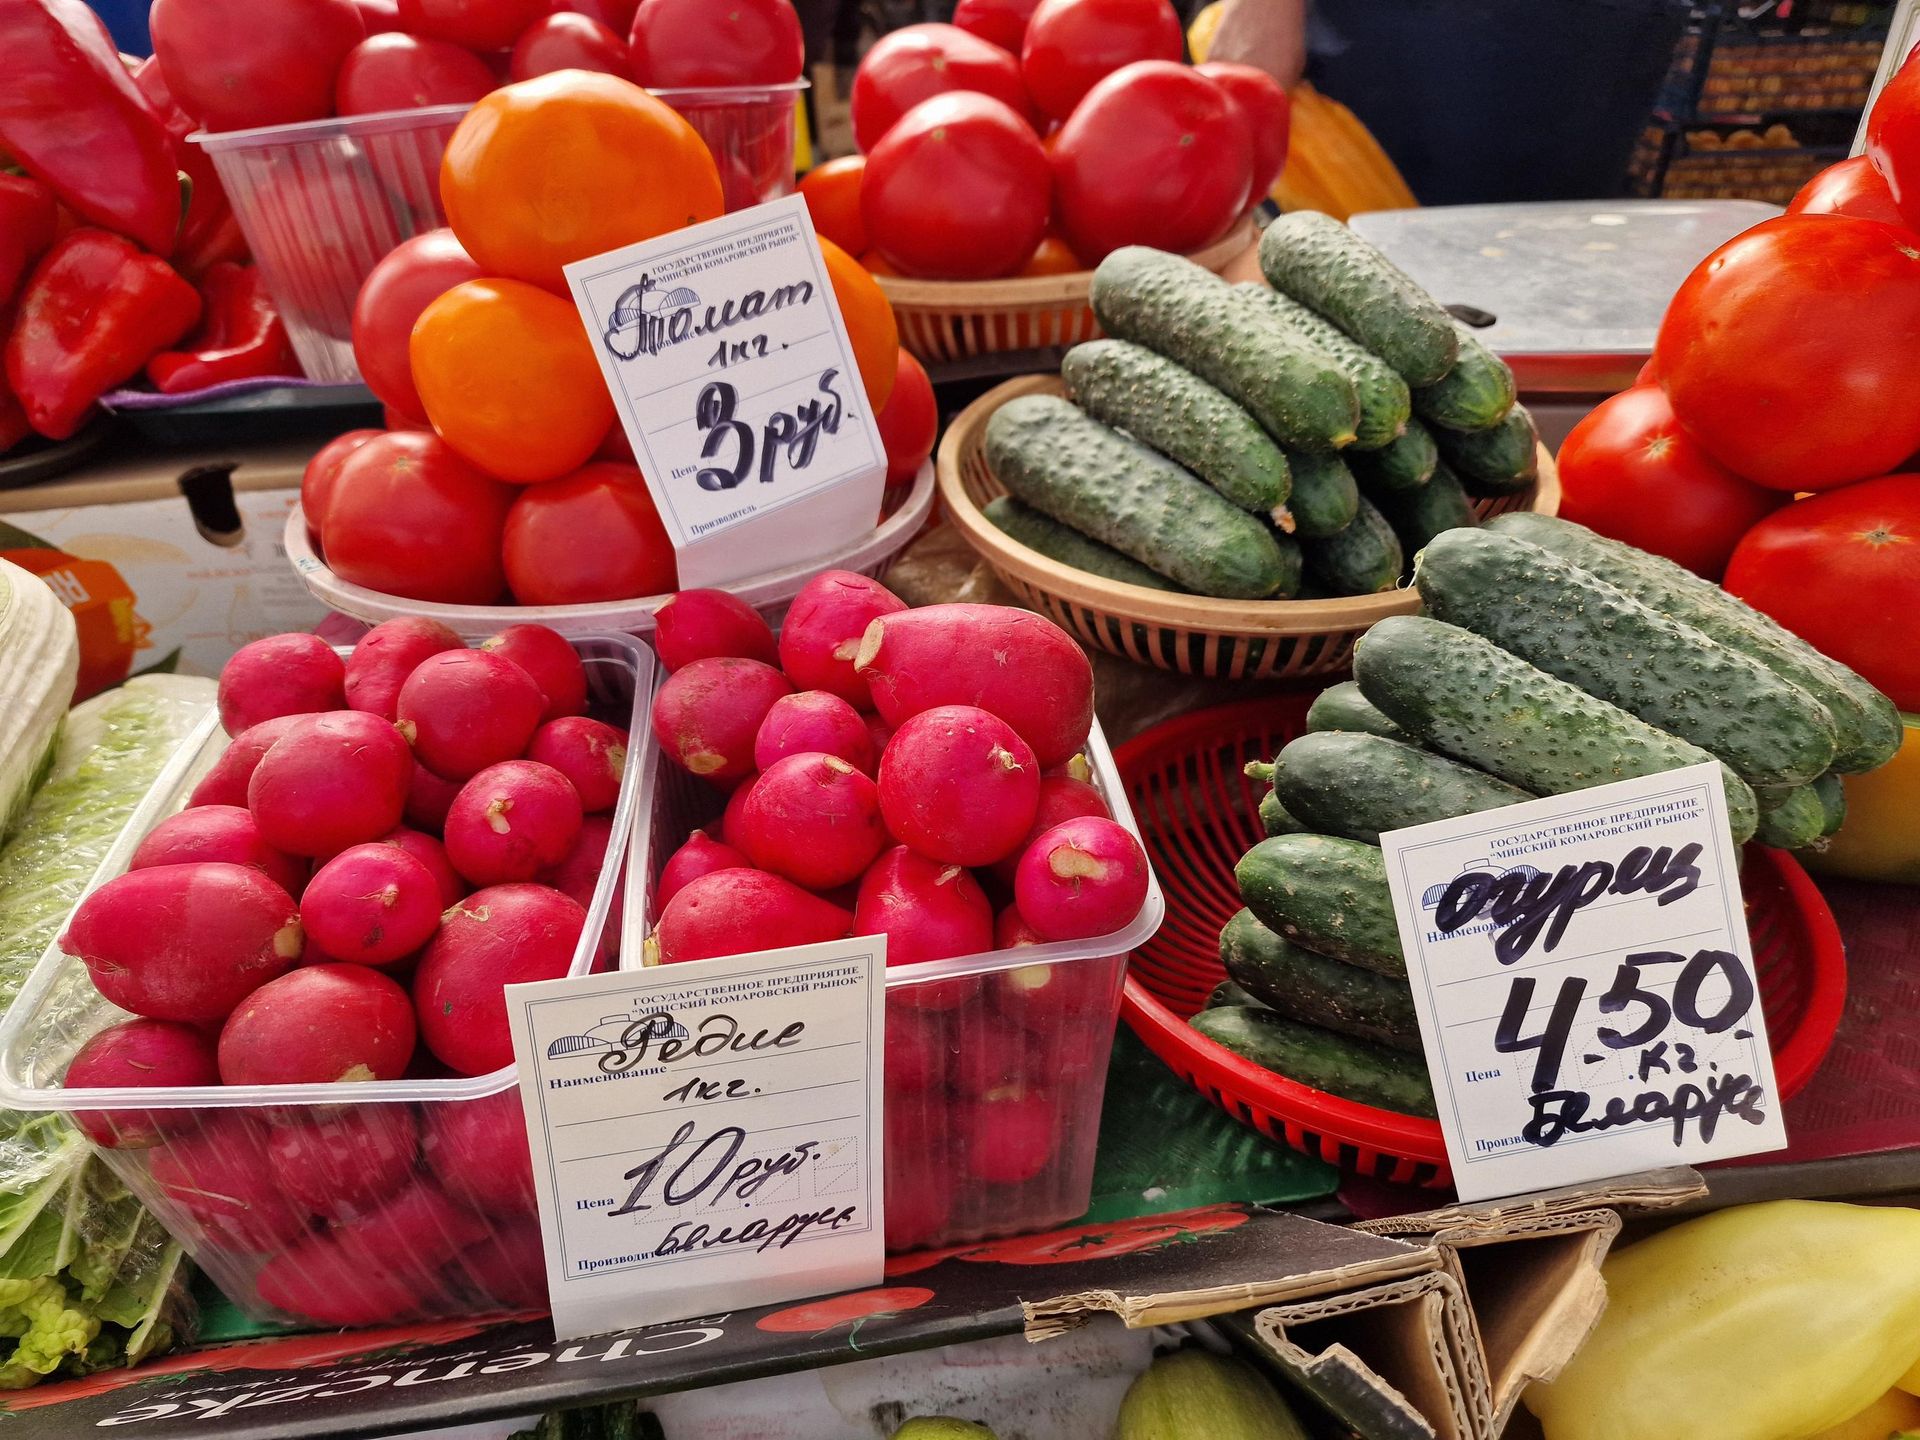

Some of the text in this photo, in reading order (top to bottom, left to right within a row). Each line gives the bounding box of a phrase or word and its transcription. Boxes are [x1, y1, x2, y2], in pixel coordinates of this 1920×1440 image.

[652, 224, 795, 276] ГОСУДАРСТВЕННОЕ ПРЕДПРИЯТИЕ
[704, 242, 768, 271] КОМАРОВСКИЙ
[696, 382, 755, 491] 3
[670, 464, 698, 480] Цена
[690, 504, 757, 536] Производитель
[1489, 797, 1698, 849] ГОСУДАРСТВЕННОЕ ПРЕДПРИЯТИЕ
[1560, 820, 1653, 849] КОМАРОВСКИЙ
[632, 966, 859, 1006] ГОСУДАРСТВЕННОЕ ПРЕДПРИЯТИЕ
[711, 982, 810, 1006] КОМАРОВСКИЙ
[549, 1065, 668, 1090] Наименование
[1465, 1068, 1501, 1083] Цена
[576, 1198, 615, 1210] Цена
